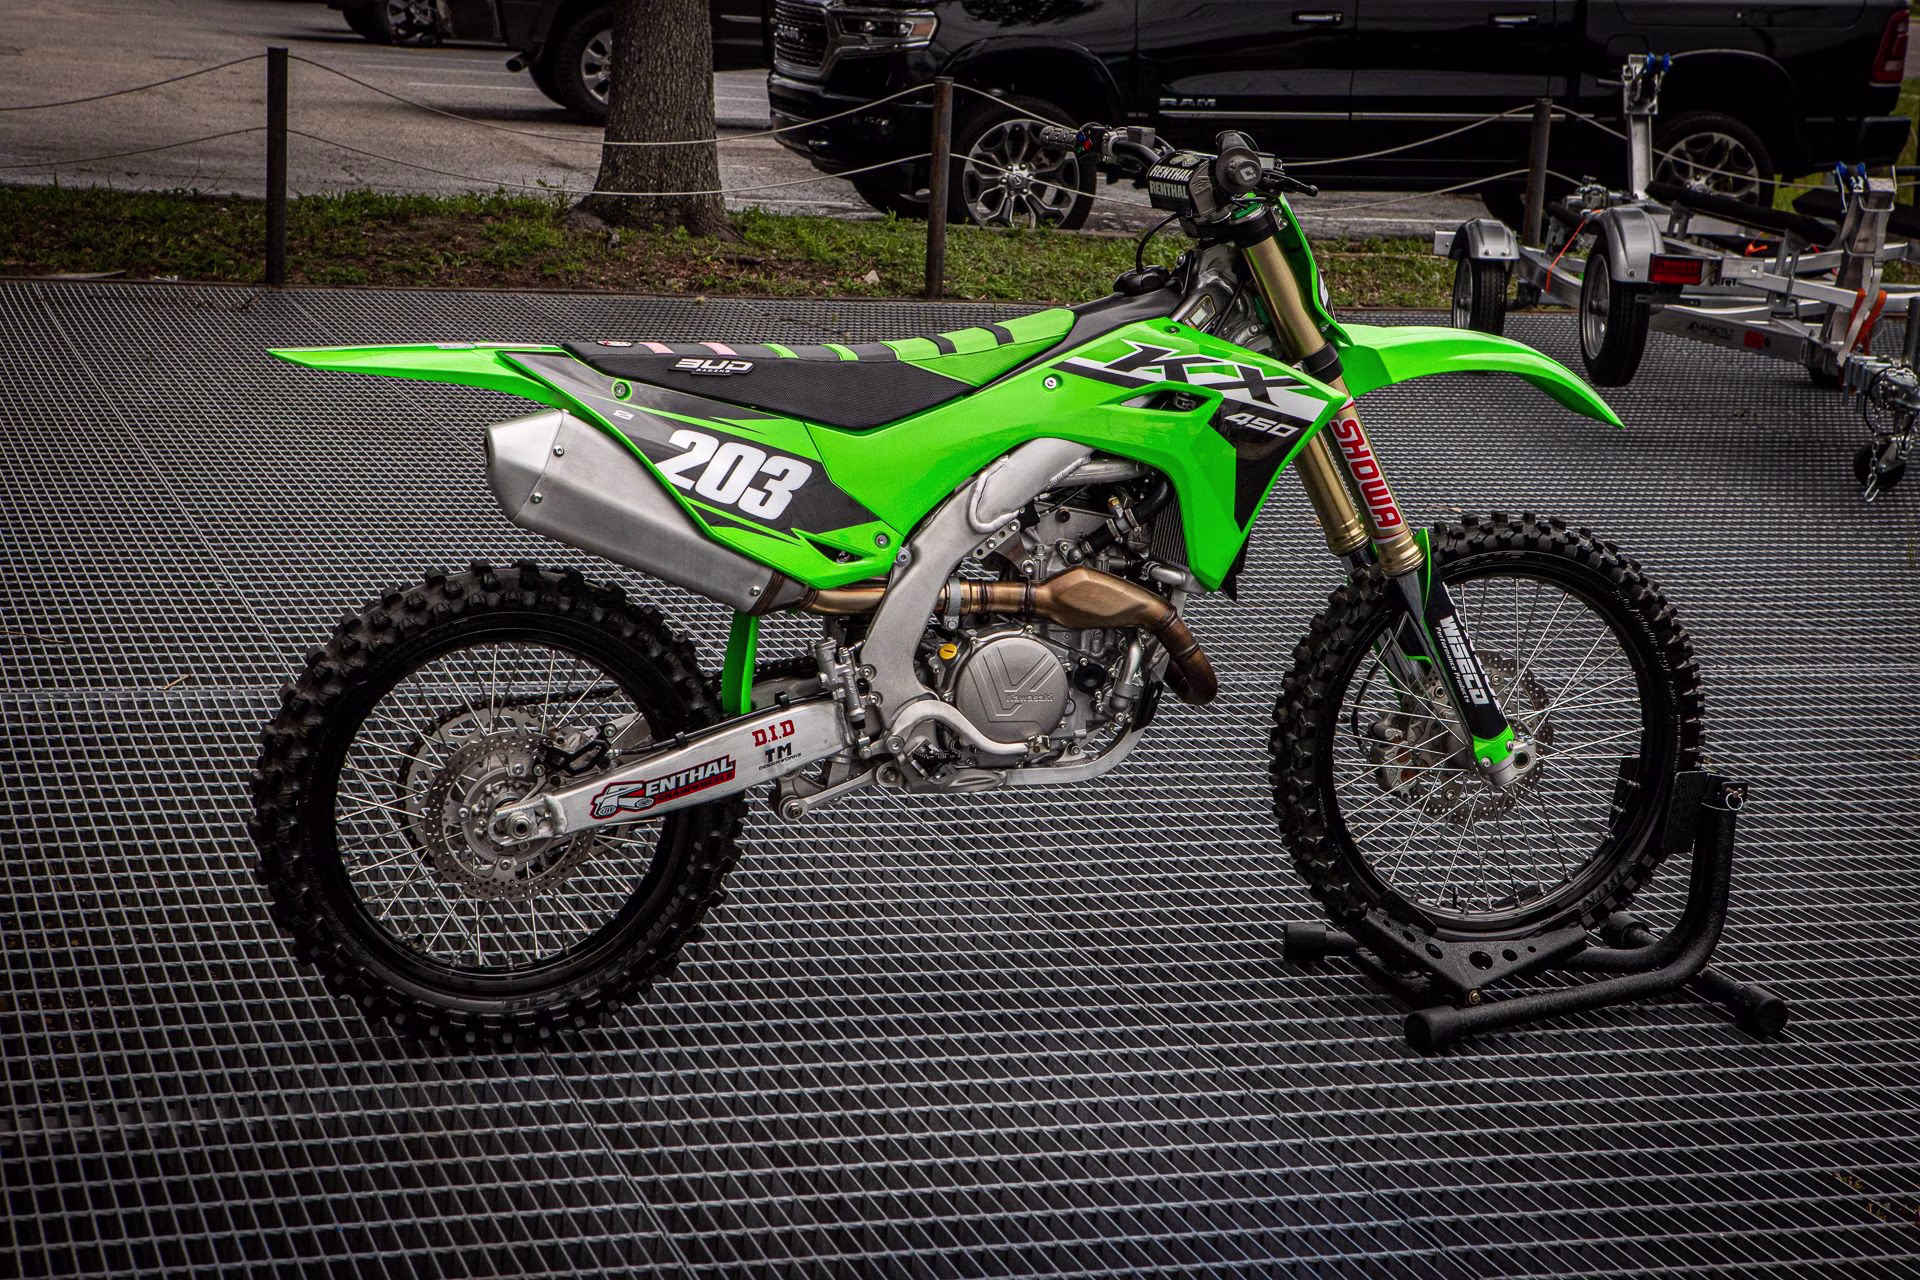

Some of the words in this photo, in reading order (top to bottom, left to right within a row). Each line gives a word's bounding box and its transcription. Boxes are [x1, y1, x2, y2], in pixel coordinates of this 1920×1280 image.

[1159, 98, 1216, 107] RAM
[1149, 165, 1194, 181] RENTHAL
[1150, 180, 1189, 199] RENTHAL
[1102, 339, 1310, 408] KX
[1223, 412, 1300, 438] 450
[654, 429, 813, 520] 203
[1330, 418, 1402, 529] SHOWA
[1454, 672, 1471, 703] Products
[752, 719, 795, 747] D.I.D
[765, 742, 792, 763] TM
